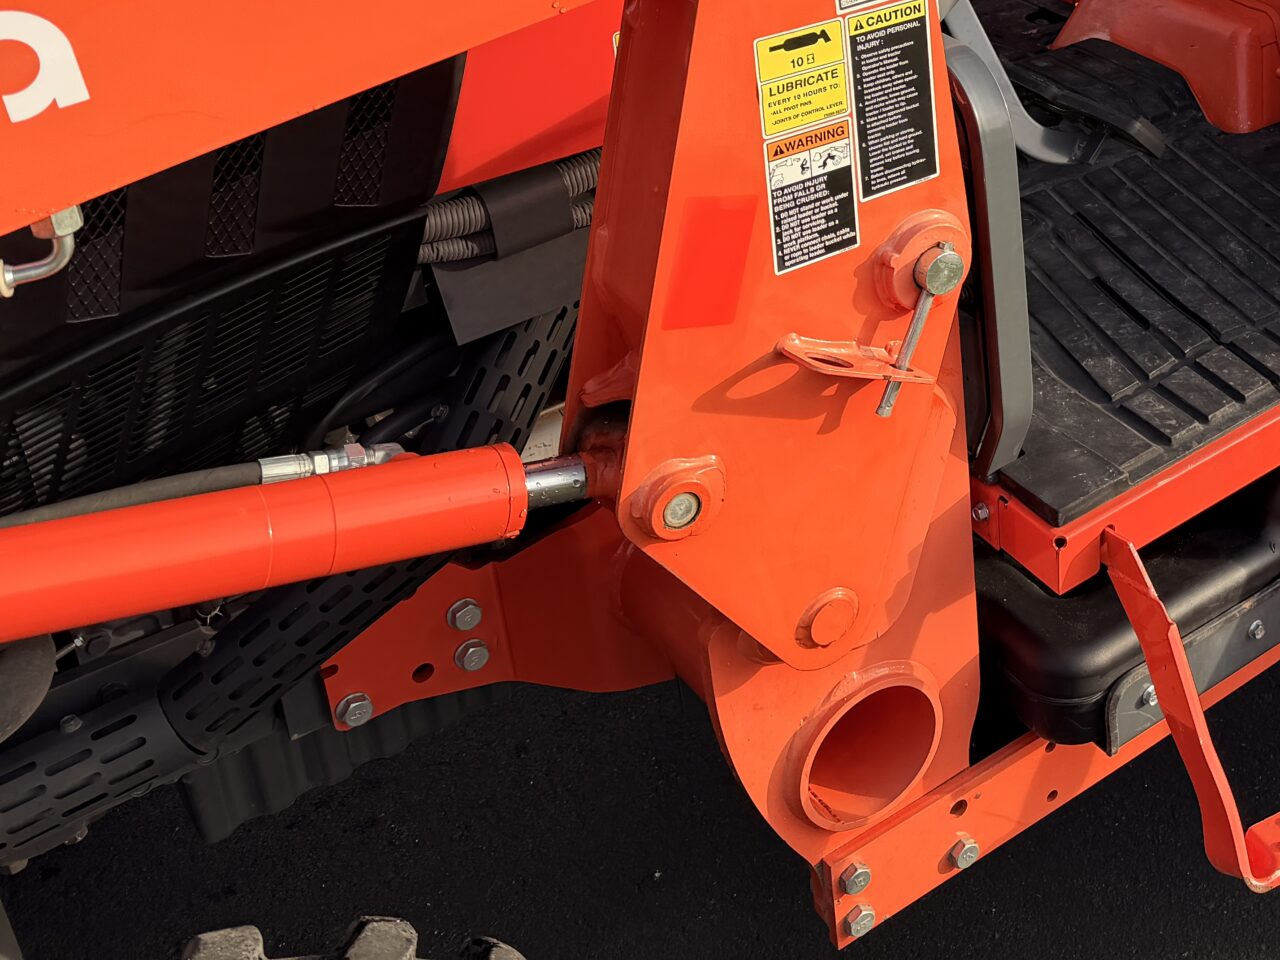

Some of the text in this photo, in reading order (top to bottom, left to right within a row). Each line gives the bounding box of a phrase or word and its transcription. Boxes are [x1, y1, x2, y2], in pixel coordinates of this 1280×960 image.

[866, 4, 921, 27] CAUTION
[866, 30, 886, 40] AVOID
[887, 21, 921, 35] PERSONAL
[857, 40, 881, 51] INJURY
[790, 57, 804, 69] 10
[769, 69, 839, 97] LUBRICATE
[768, 97, 791, 108] EVERY
[803, 87, 827, 98] HOURS
[801, 106, 825, 117] CONTROL
[784, 126, 845, 151] WARNING
[783, 184, 804, 195] AVOID
[805, 176, 828, 188] INJURY
[774, 194, 793, 205] FROM
[794, 187, 815, 198] FALLS
[774, 189, 830, 213] BEING CRUSHED:
[800, 203, 814, 212] stand
[835, 191, 849, 200] under
[798, 210, 814, 219] loader
[811, 212, 827, 221] loader
[812, 223, 828, 232] loader
[784, 245, 800, 255] NEVER
